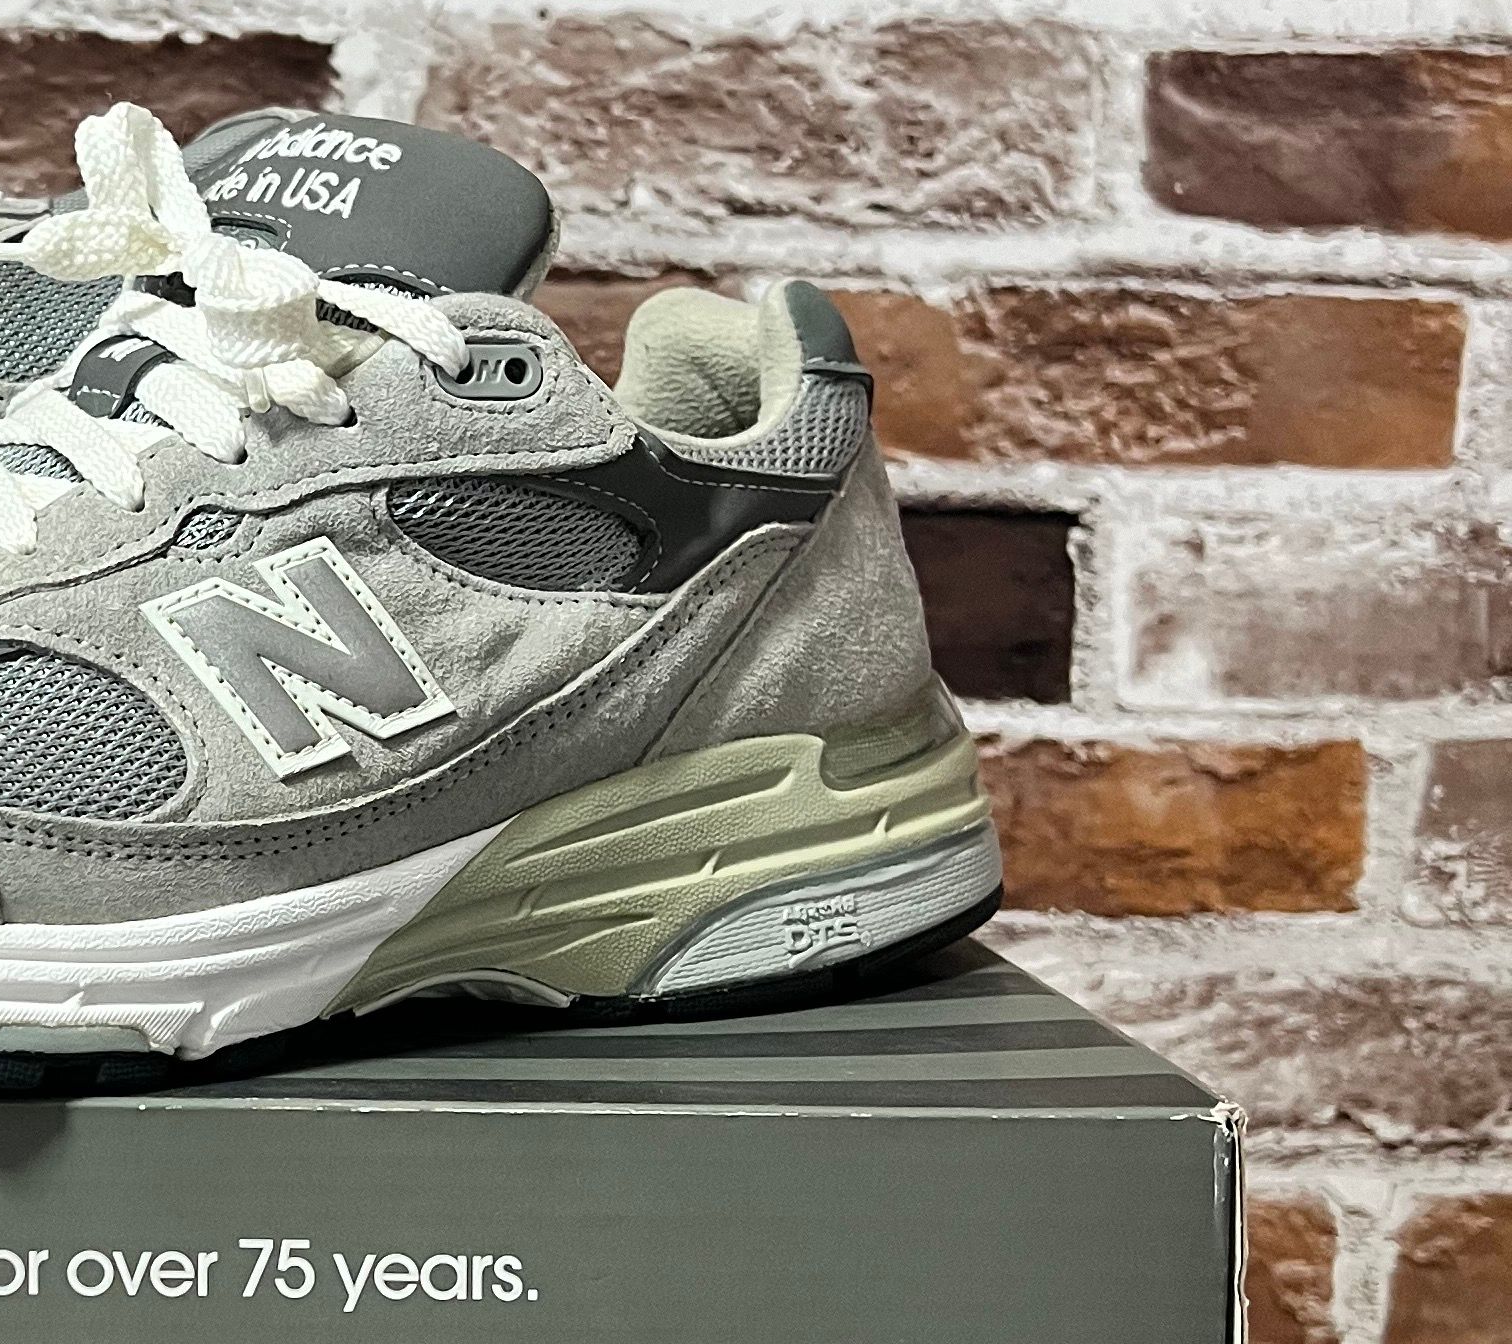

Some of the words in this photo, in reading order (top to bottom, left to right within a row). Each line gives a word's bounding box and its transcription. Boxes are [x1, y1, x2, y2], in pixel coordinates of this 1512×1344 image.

[257, 122, 403, 170] balance
[246, 166, 281, 203] in
[281, 167, 361, 219] USA
[139, 535, 457, 780] N
[66, 1249, 219, 1298] over
[238, 1238, 316, 1299] 75
[332, 1253, 539, 1313] years.
